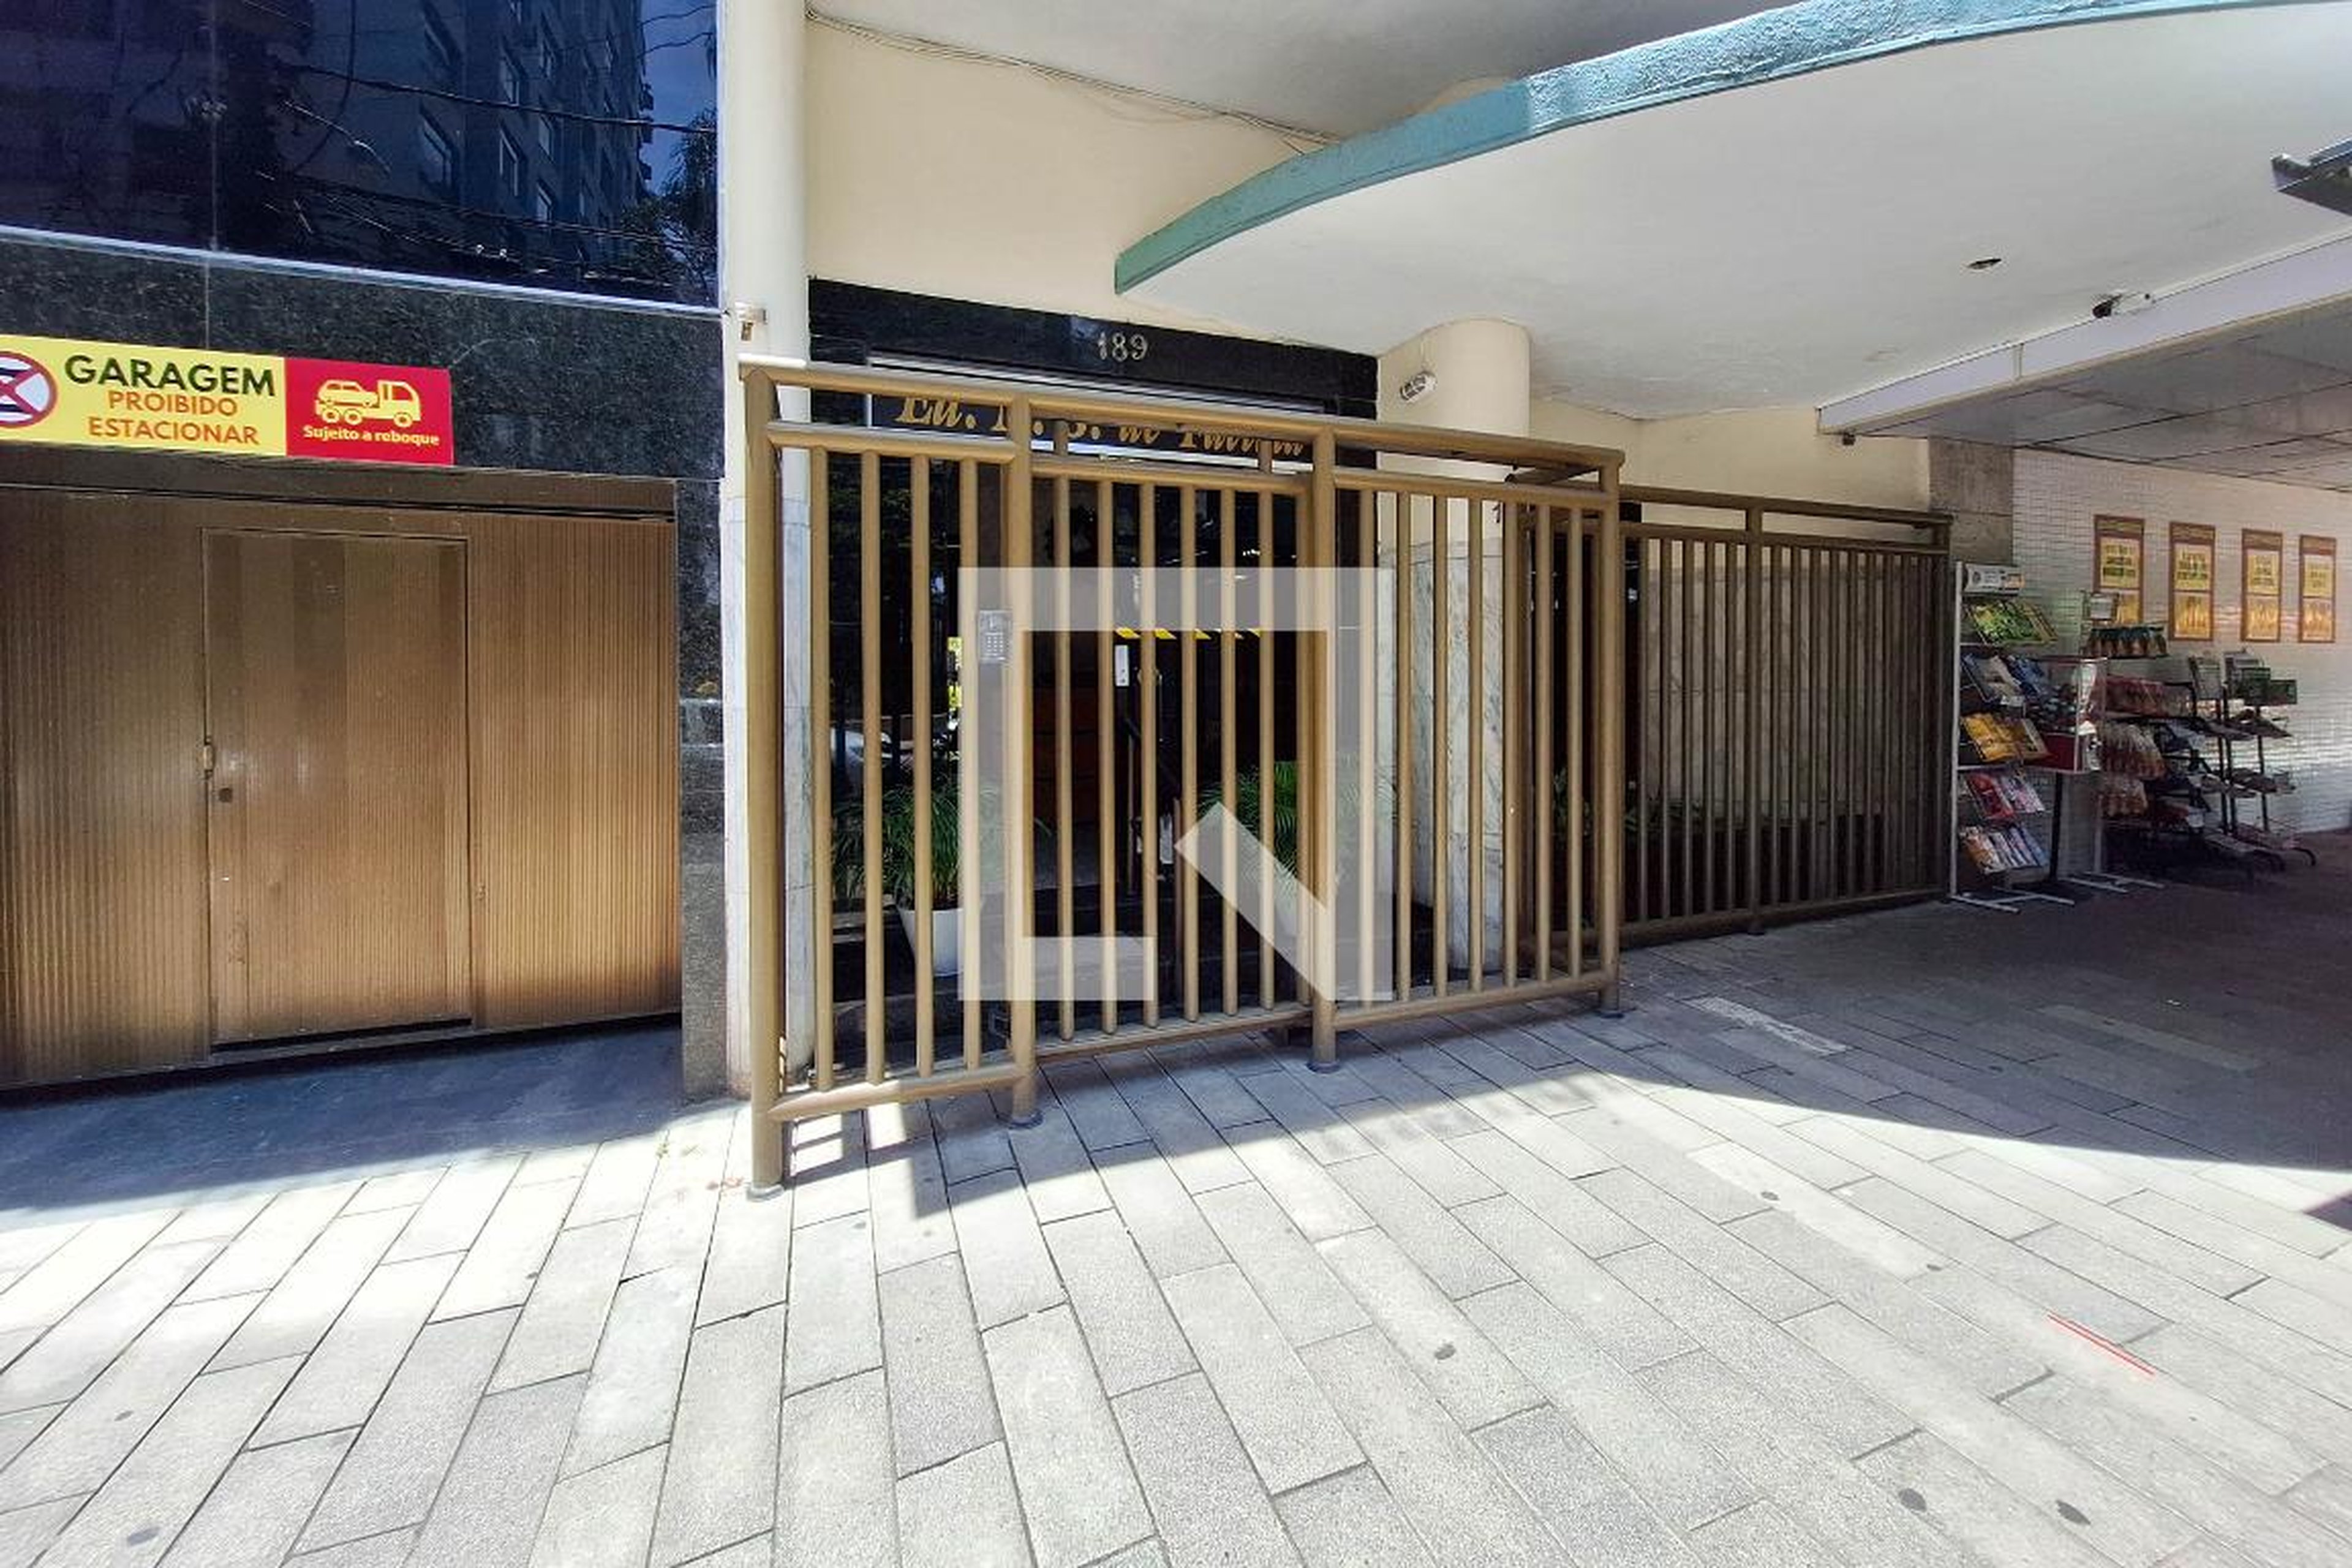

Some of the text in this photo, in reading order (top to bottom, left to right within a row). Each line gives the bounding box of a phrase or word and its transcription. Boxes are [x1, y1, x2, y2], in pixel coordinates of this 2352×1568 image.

[1098, 331, 1148, 362] 189
[64, 355, 275, 397] GARAGEM
[108, 390, 238, 417] PROIBIDO
[88, 417, 259, 445] ESTACIONAR
[303, 424, 440, 447] Sujeito a reboque
